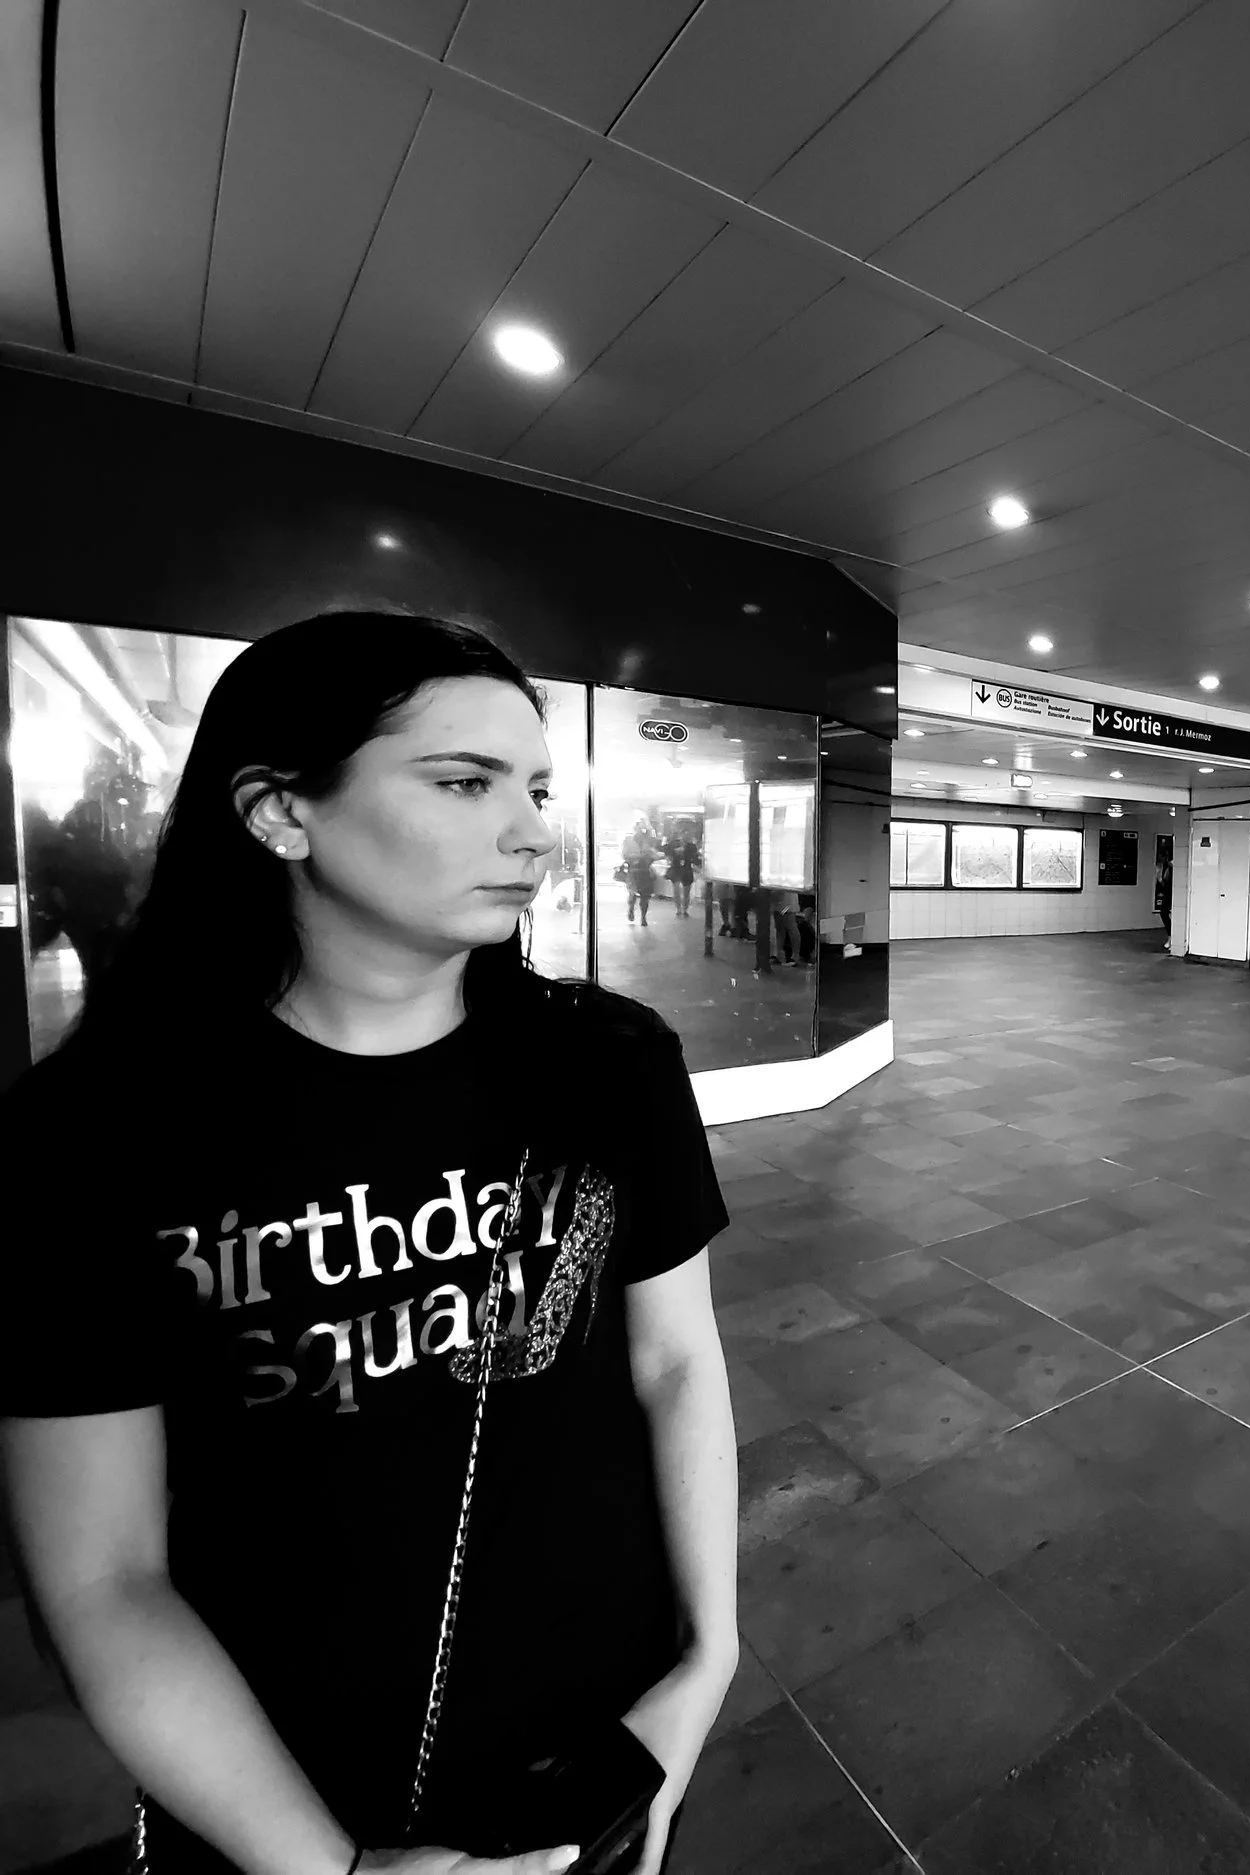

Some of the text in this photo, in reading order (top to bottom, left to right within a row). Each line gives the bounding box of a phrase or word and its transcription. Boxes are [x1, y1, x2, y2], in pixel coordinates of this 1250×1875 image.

[998, 694, 1010, 702] BUS
[1013, 691, 1027, 699] Gare
[1112, 710, 1162, 736] Sortie
[1165, 726, 1170, 735] 1
[1185, 729, 1212, 742] Mermoz
[156, 1164, 569, 1312] Birthday
